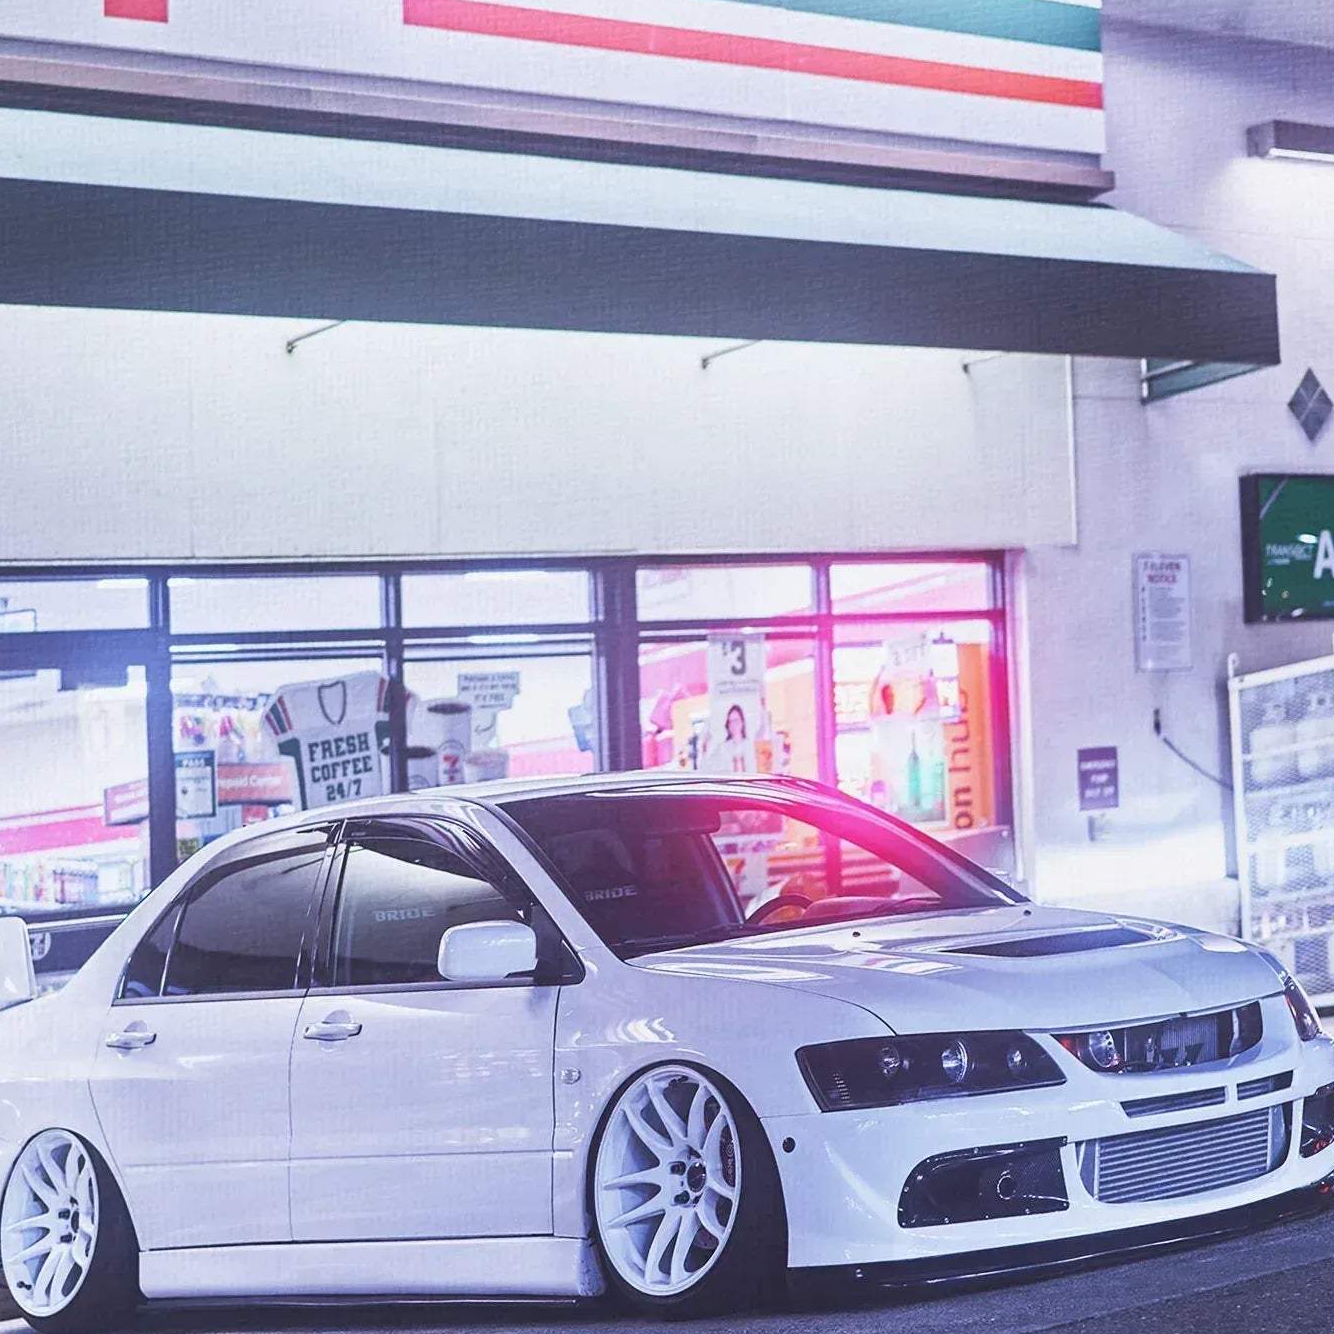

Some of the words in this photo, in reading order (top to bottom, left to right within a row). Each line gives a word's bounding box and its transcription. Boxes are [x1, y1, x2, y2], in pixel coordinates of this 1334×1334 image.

[308, 732, 370, 763] FRESH
[311, 755, 373, 783] COFFEE
[326, 779, 362, 801] 24/7
[584, 885, 637, 901] BRIDE
[375, 908, 435, 922] BRIDE
